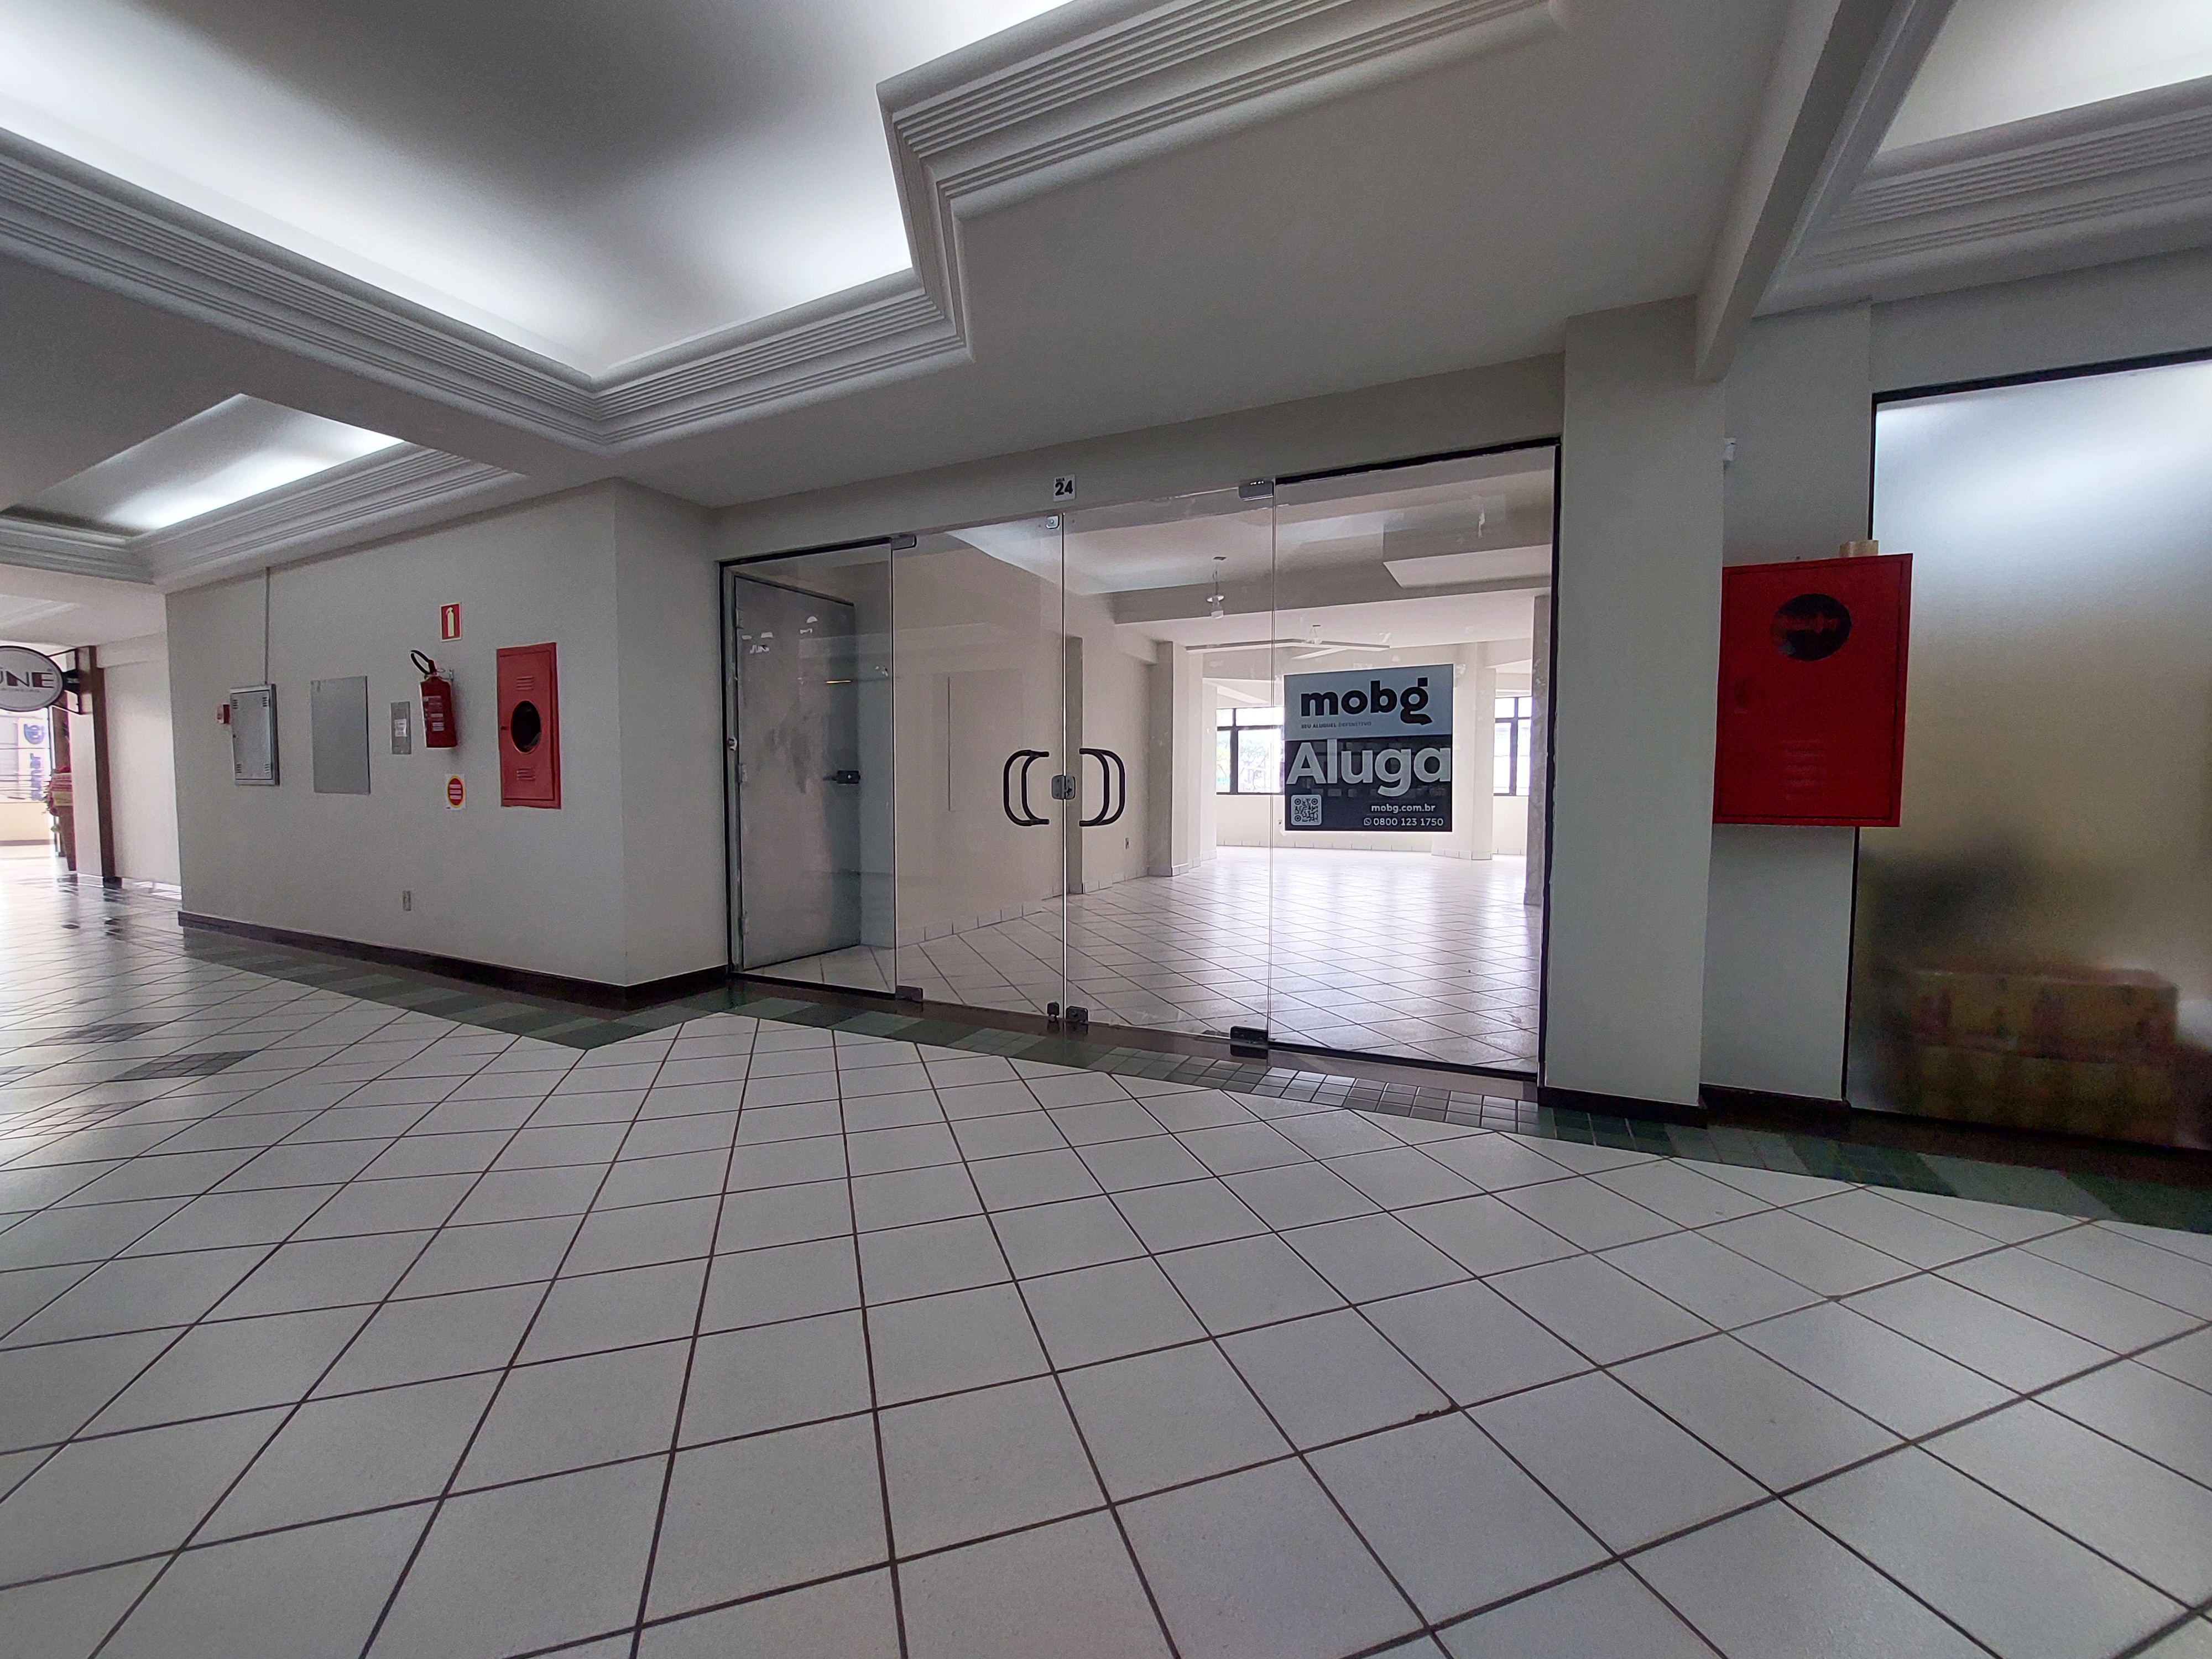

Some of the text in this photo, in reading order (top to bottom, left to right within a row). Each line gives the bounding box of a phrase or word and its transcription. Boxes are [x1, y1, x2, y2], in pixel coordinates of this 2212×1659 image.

[1055, 480, 1073, 496] 24
[0, 667, 54, 688] NE
[1301, 677, 1432, 726] mobg
[1286, 739, 1451, 797] Aluga
[1371, 804, 1436, 813] mobg.com.br
[1373, 817, 1444, 826] 0800 123 1750
